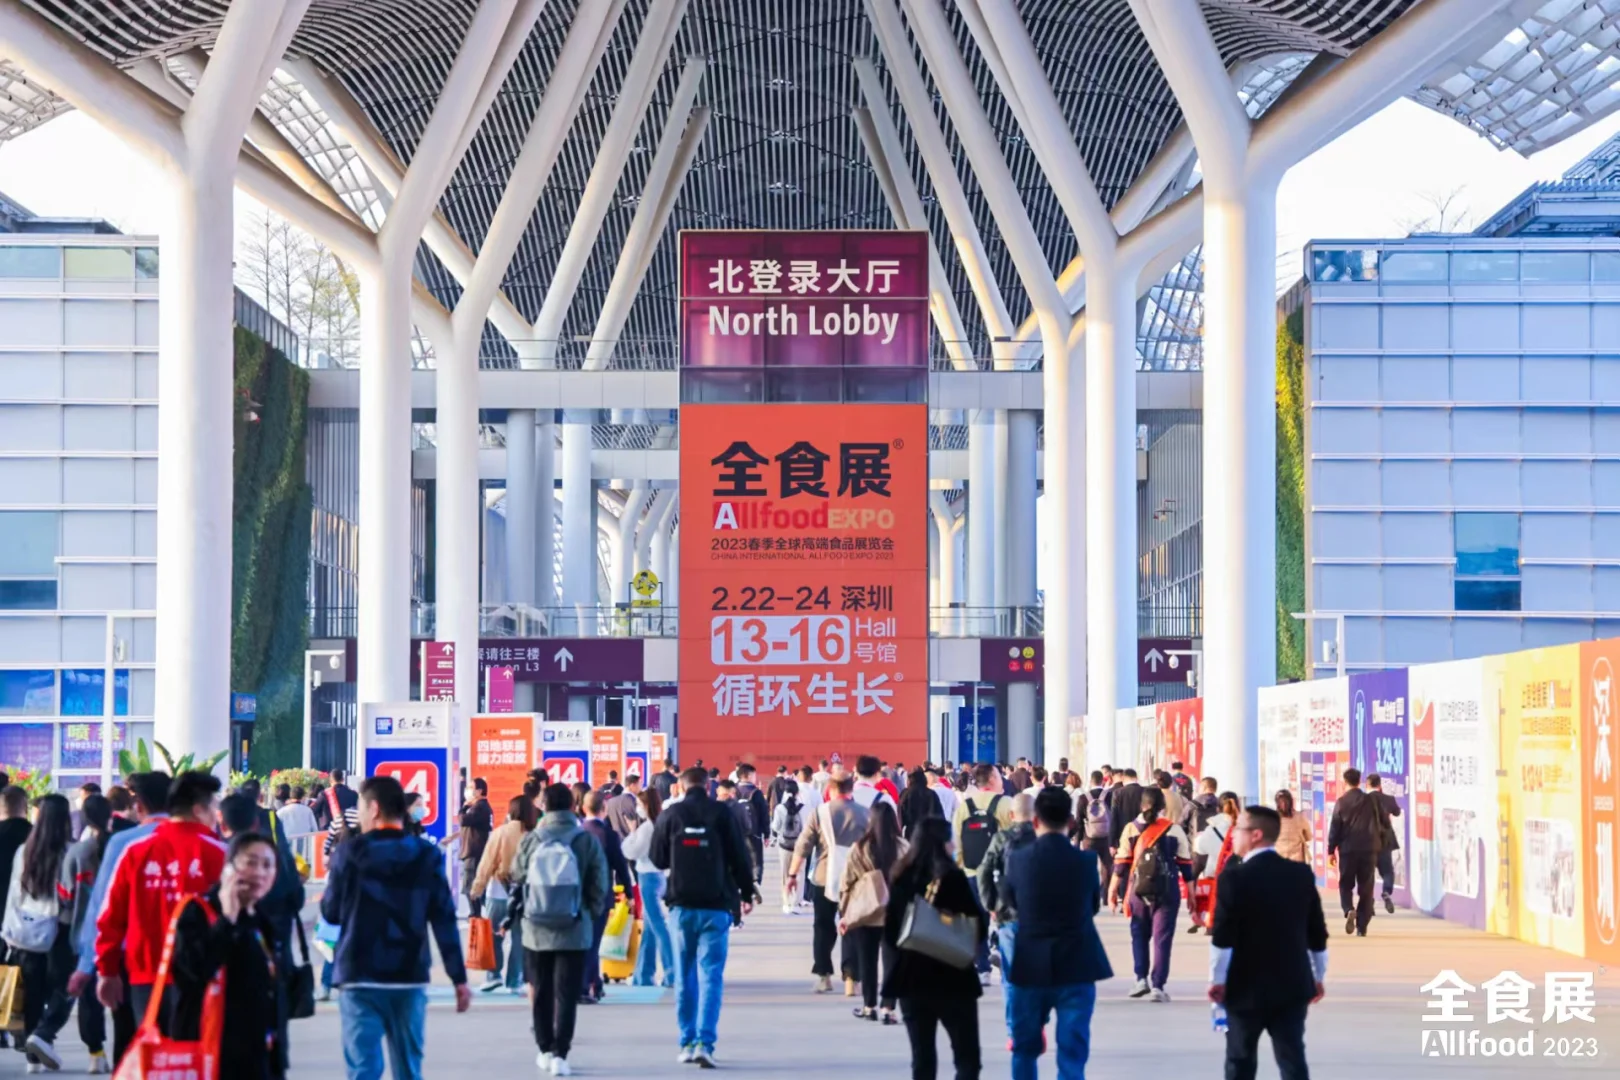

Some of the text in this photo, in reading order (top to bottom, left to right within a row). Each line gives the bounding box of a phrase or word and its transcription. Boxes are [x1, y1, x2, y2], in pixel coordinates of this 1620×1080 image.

[708, 259, 900, 294] 北登录大厅
[708, 303, 899, 345] North Lobby
[711, 441, 892, 499] 全食展
[710, 551, 738, 561] CHINA
[711, 538, 894, 551] 2023春季全球高端食品展览会
[841, 585, 893, 611] 深圳
[713, 617, 844, 662] 13-16
[855, 618, 897, 637] Hall
[854, 642, 898, 663] 号馆
[712, 672, 894, 716] 循环生长
